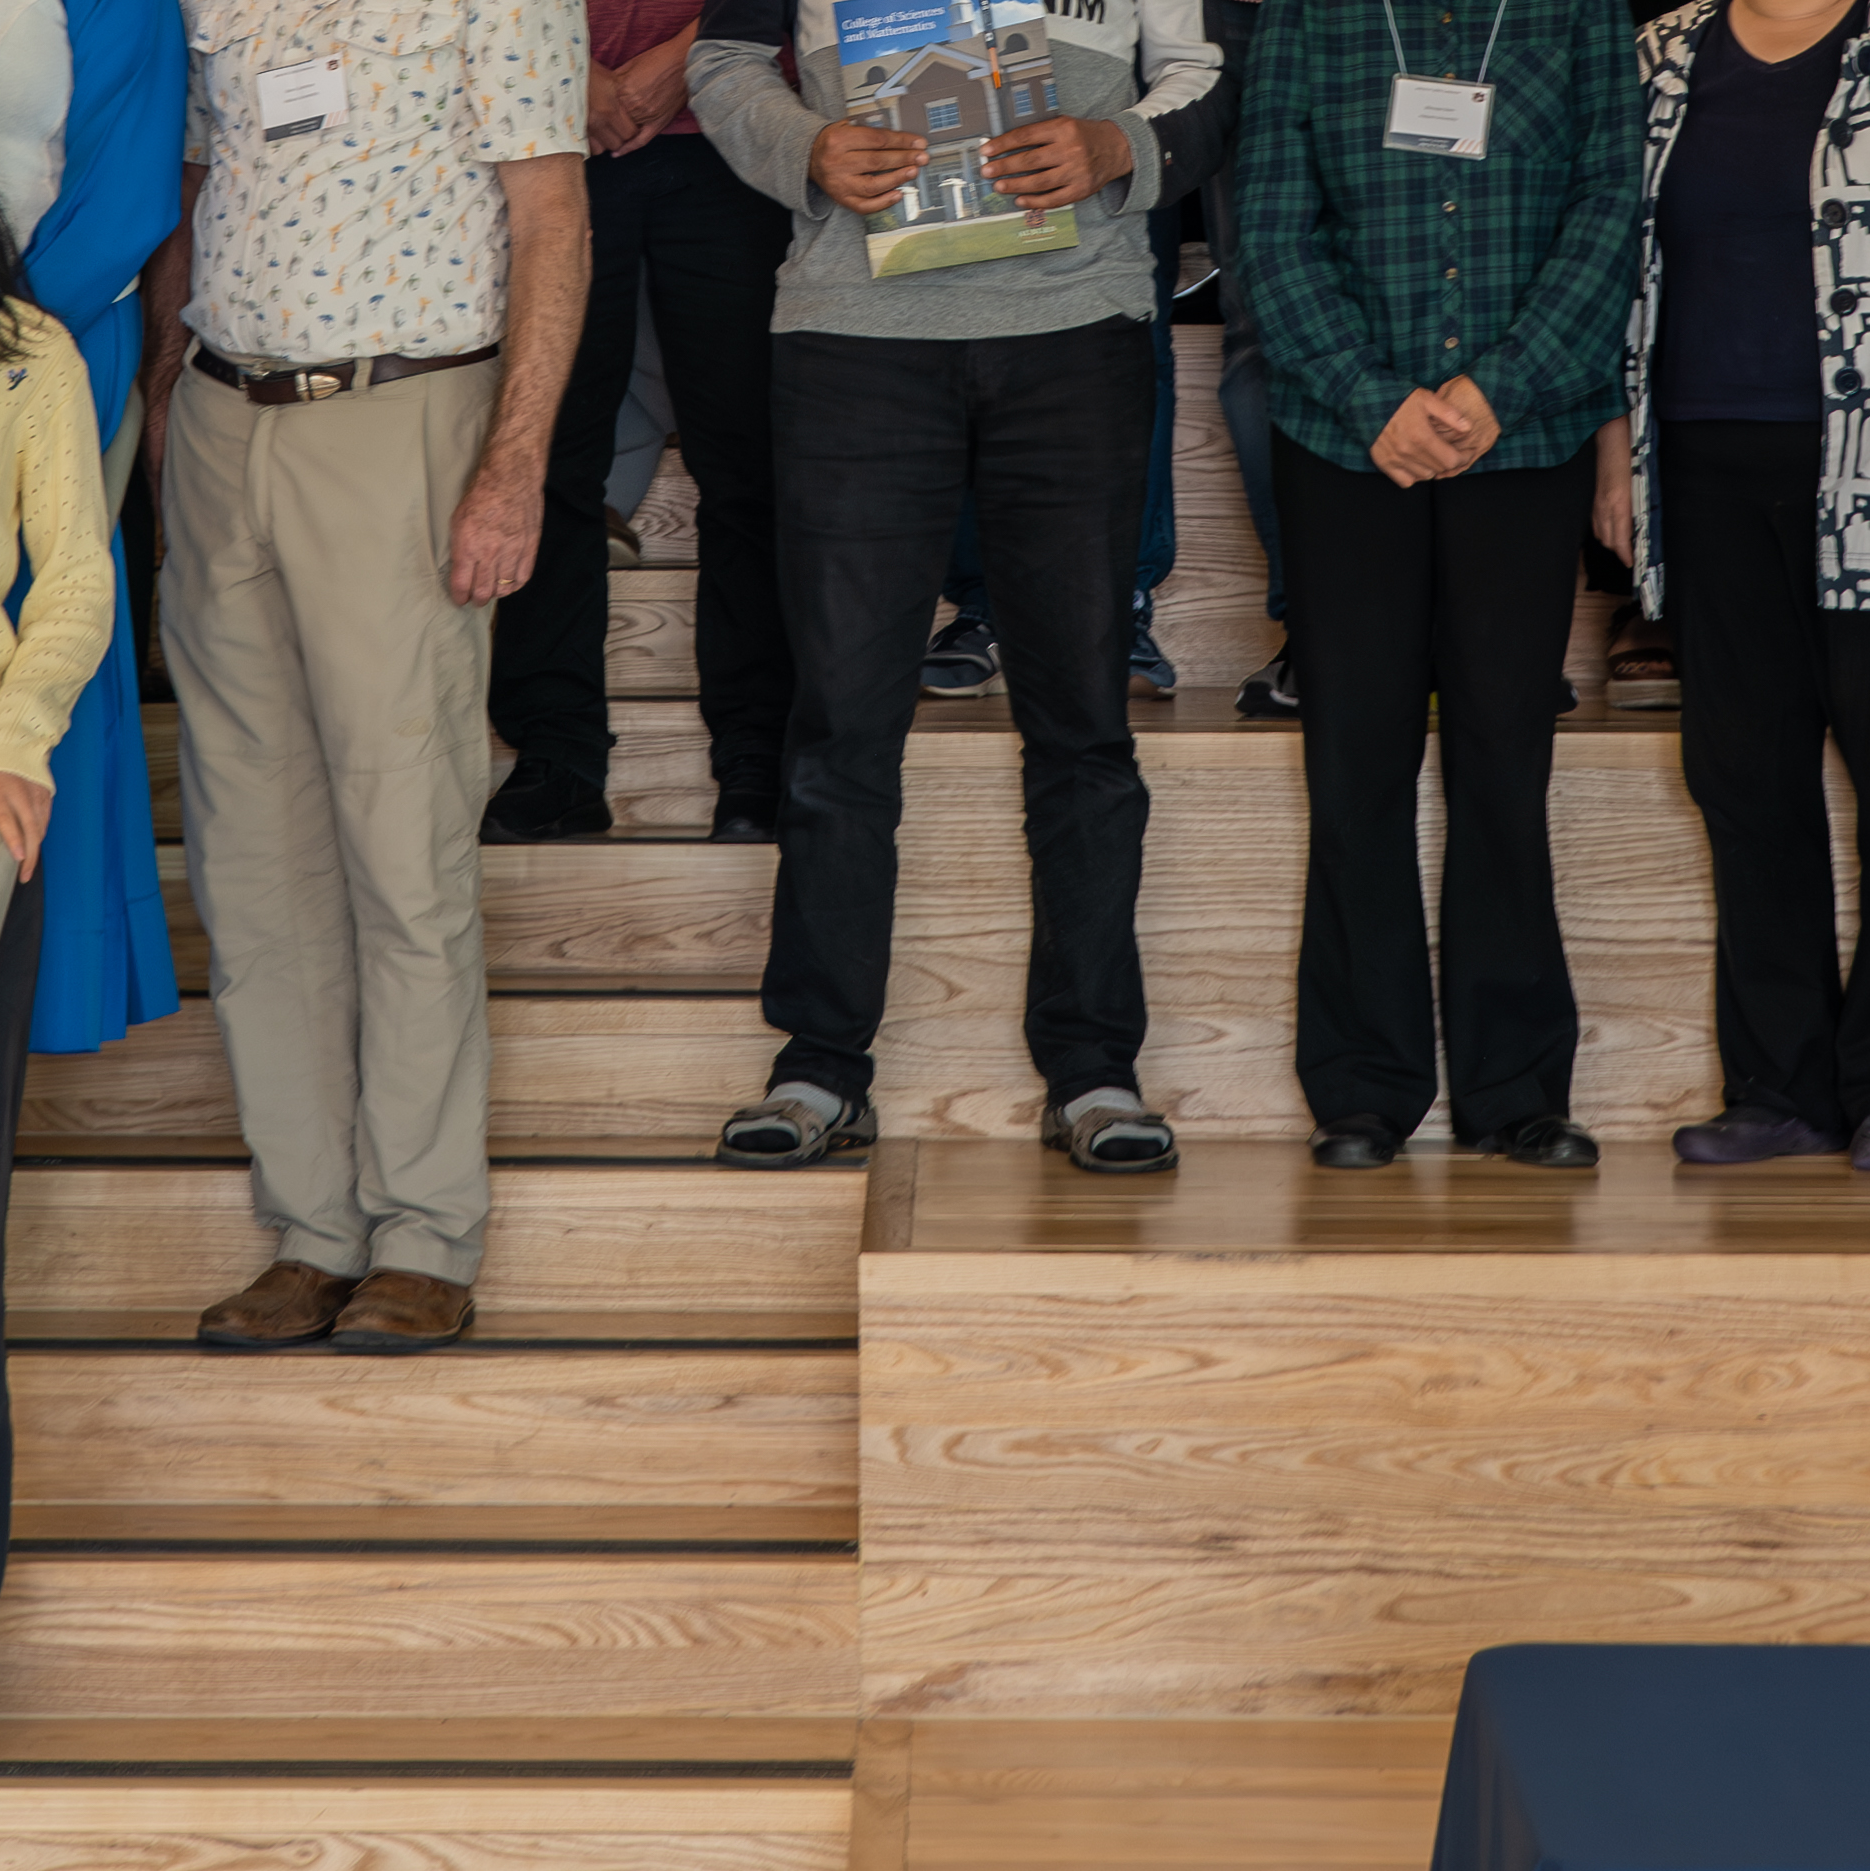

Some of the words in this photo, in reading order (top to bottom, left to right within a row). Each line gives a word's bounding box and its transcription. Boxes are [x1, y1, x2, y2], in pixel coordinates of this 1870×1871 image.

[841, 16, 883, 30] College
[897, 7, 945, 21] Sciences
[843, 29, 866, 43] and
[867, 22, 936, 38] Mathematics
